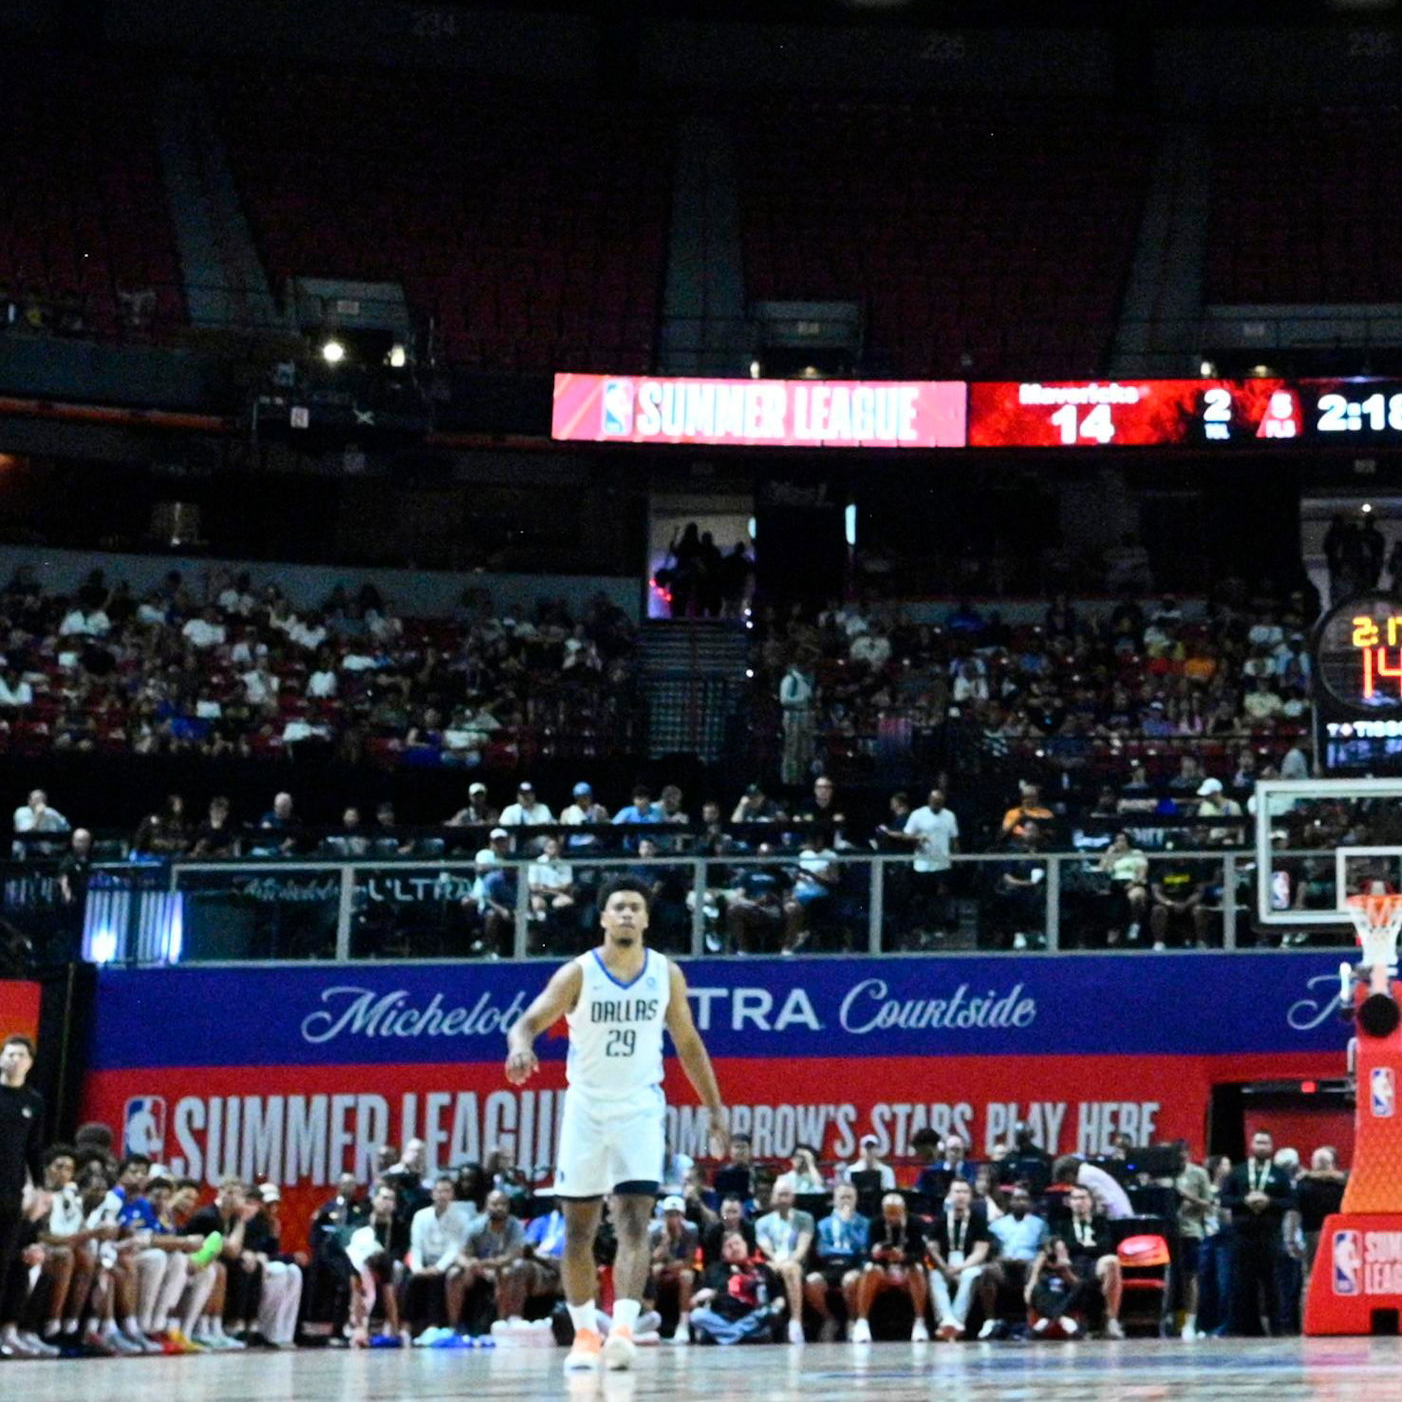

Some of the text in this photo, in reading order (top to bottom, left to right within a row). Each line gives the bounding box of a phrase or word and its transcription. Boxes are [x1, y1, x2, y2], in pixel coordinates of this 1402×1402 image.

[636, 382, 919, 441] SUMMER LEAGUE
[1051, 403, 1115, 444] 14
[1203, 388, 1232, 421] 2
[301, 978, 1037, 1044] Michelob TRA Courtside
[591, 1000, 659, 1024] DALLAS
[605, 1029, 637, 1058] 29
[171, 1090, 569, 1189] SUMMER LEAGU
